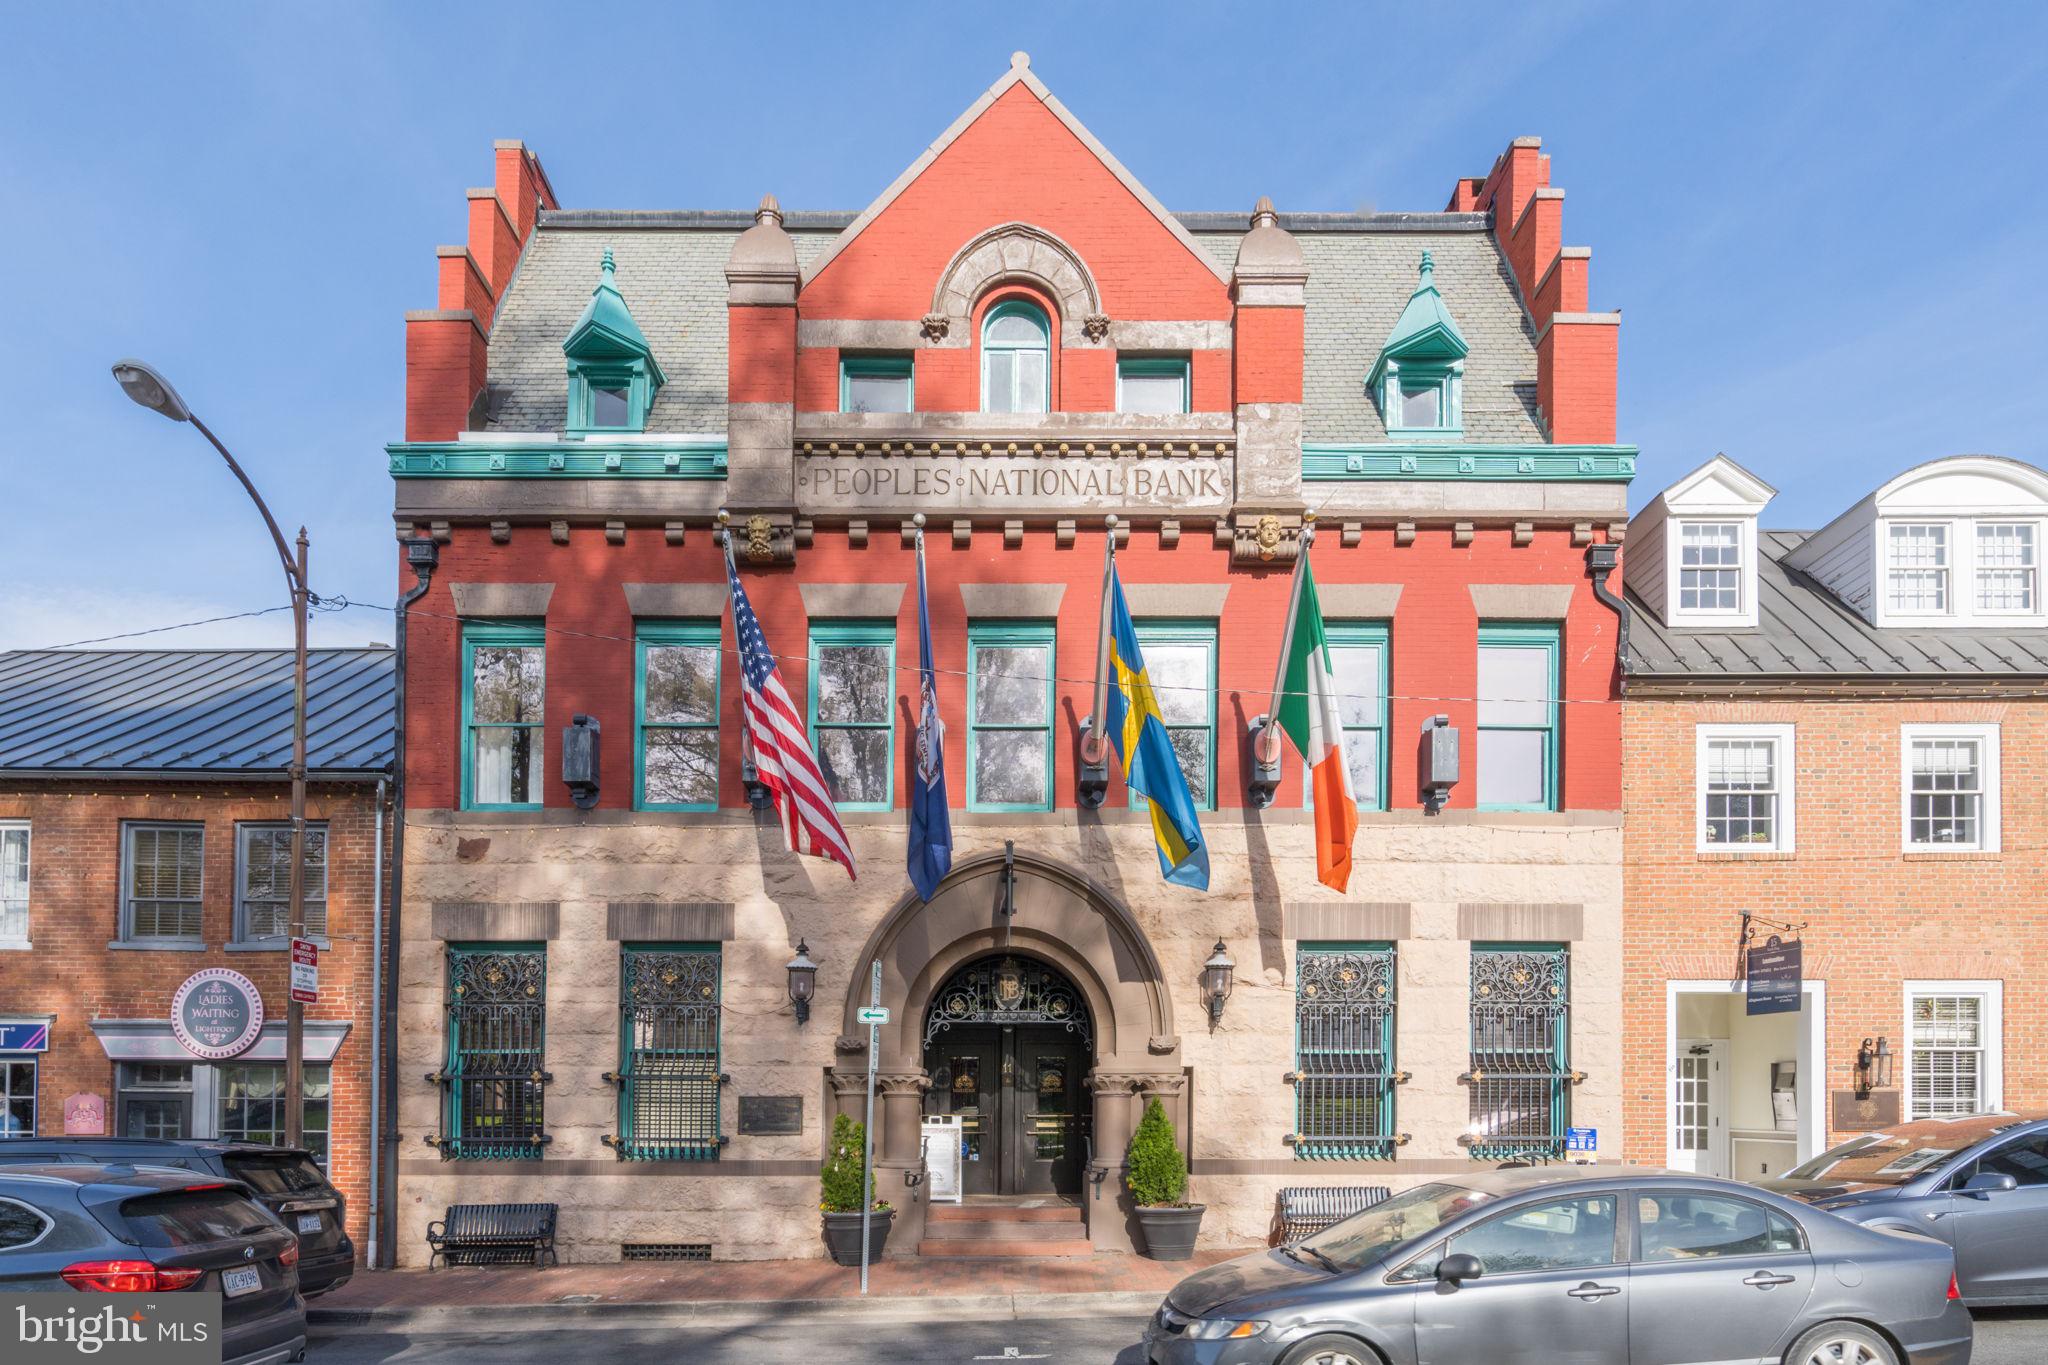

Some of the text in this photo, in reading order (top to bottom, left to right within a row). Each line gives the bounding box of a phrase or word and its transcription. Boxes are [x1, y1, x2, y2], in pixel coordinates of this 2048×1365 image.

[812, 467, 1224, 497] PEOPLES NATIONAL BANK
[198, 994, 234, 1006] LADIES
[191, 1007, 240, 1019] WAITING
[195, 1025, 236, 1033] LIGHTFOOT
